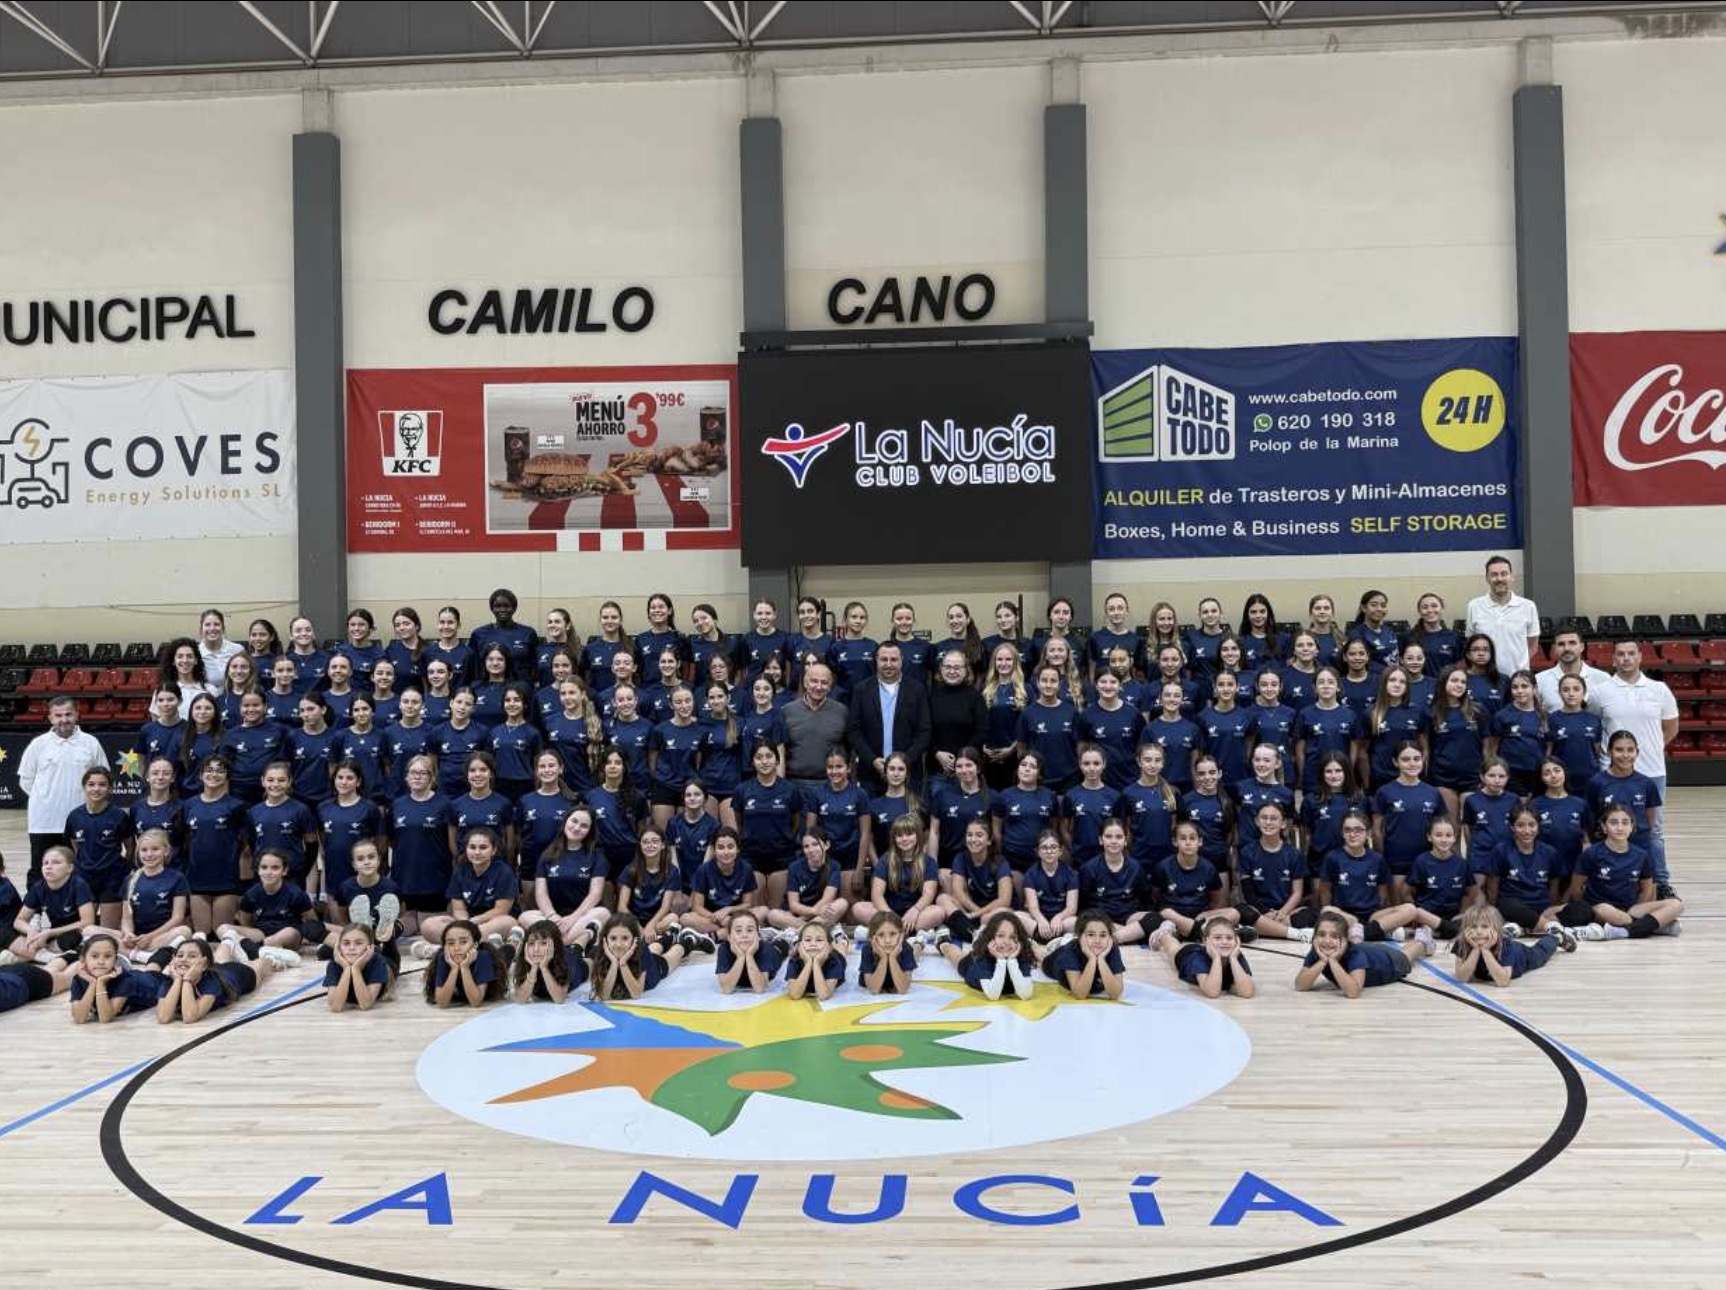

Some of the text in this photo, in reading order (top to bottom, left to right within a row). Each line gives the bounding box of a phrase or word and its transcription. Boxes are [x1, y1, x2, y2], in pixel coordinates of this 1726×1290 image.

[428, 286, 655, 335] CAMILO
[828, 273, 996, 324] CANO
[3, 294, 256, 346] UNICIPAL
[576, 395, 625, 422] MENÚ
[1166, 375, 1229, 426] CABE
[1248, 388, 1398, 405] www.cabetodo.com
[577, 421, 626, 436] AHORRO
[1277, 411, 1396, 430] 620 190 318
[856, 413, 1055, 464] La Nucía
[1167, 416, 1230, 456] TODO
[1249, 435, 1400, 454] Polop de la Marina
[84, 431, 281, 480] COVES
[391, 459, 432, 473] KFC
[855, 462, 1056, 487] CLUB VOLEIBOL
[85, 482, 281, 505] Energy Solutions SL
[1104, 483, 1508, 506] ALQUILER de Trasteros y Mini-Almacenes
[1105, 513, 1507, 540] Boxes, Home & Business SELF STORAGE
[242, 1171, 454, 1226] LA
